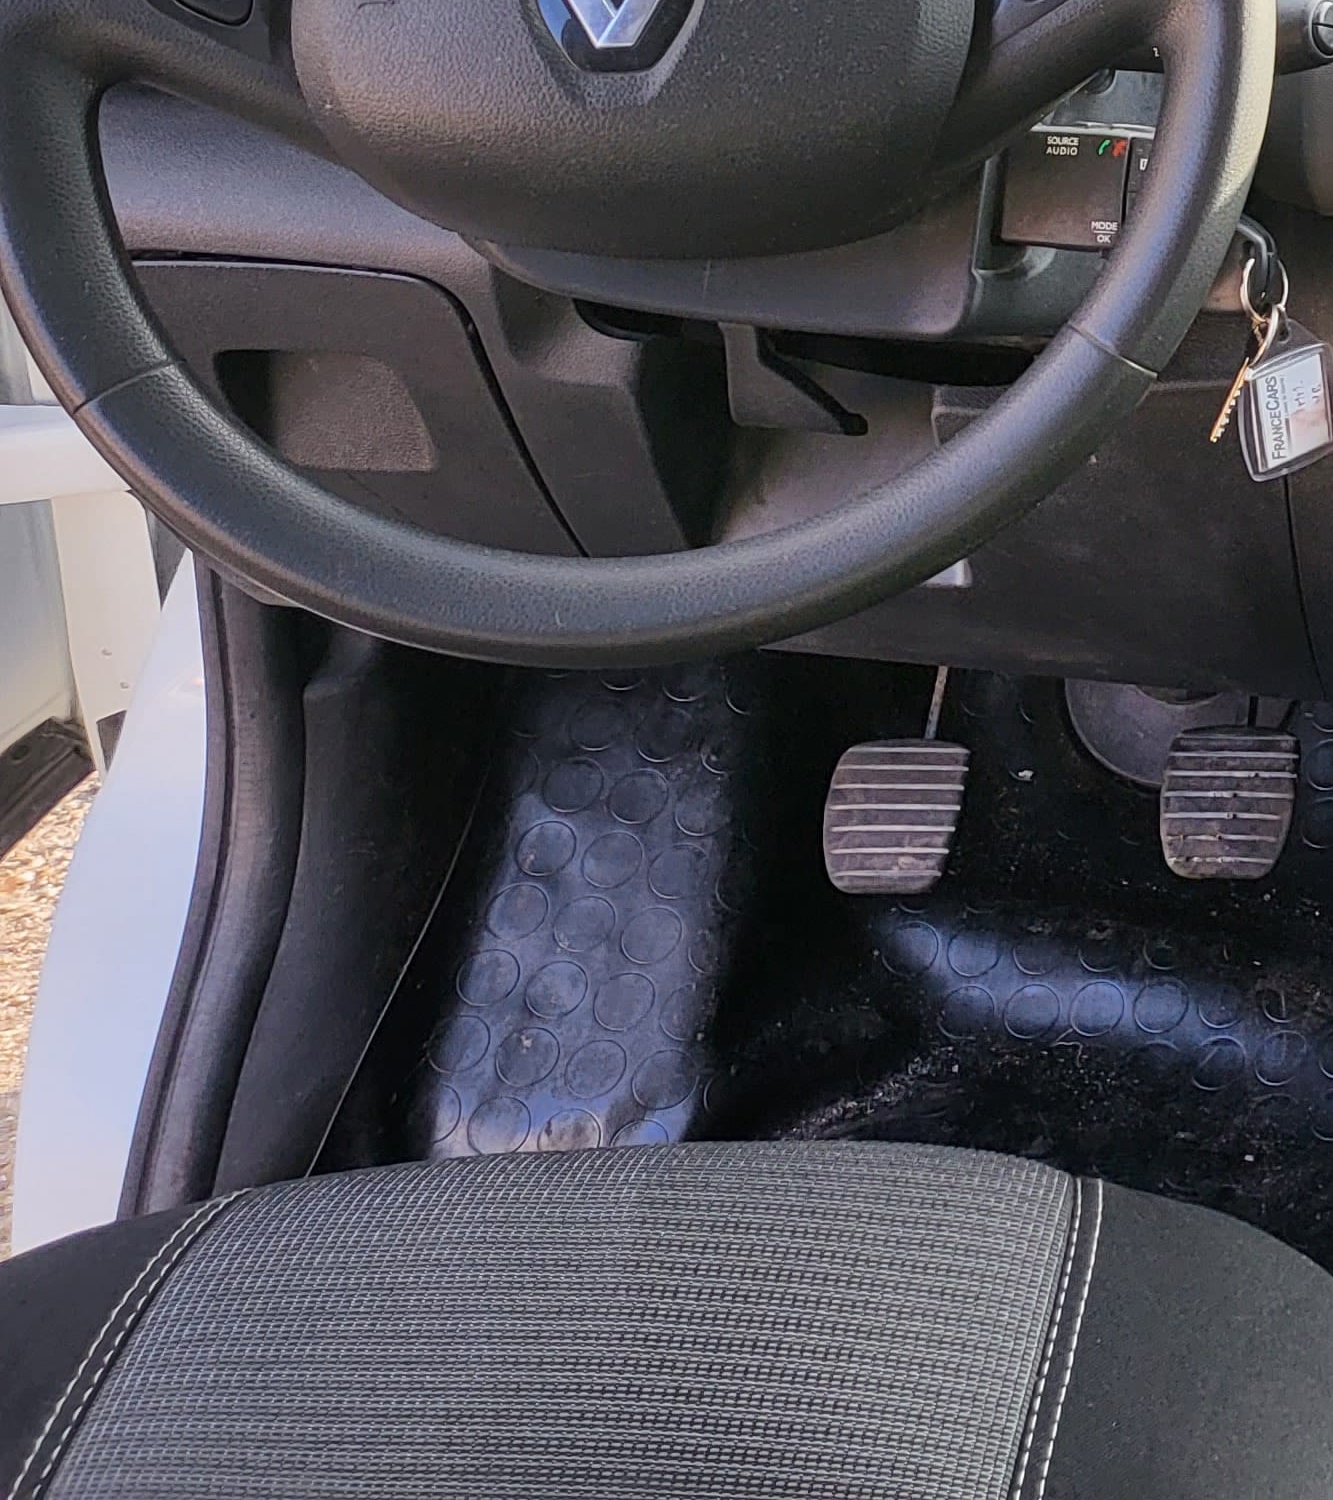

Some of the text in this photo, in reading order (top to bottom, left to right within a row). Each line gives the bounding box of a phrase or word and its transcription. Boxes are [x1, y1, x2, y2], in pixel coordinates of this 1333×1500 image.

[1047, 135, 1080, 146] SOURCE
[1046, 146, 1079, 156] AUDIO
[1091, 221, 1118, 231] MODE
[1096, 234, 1111, 244] OK
